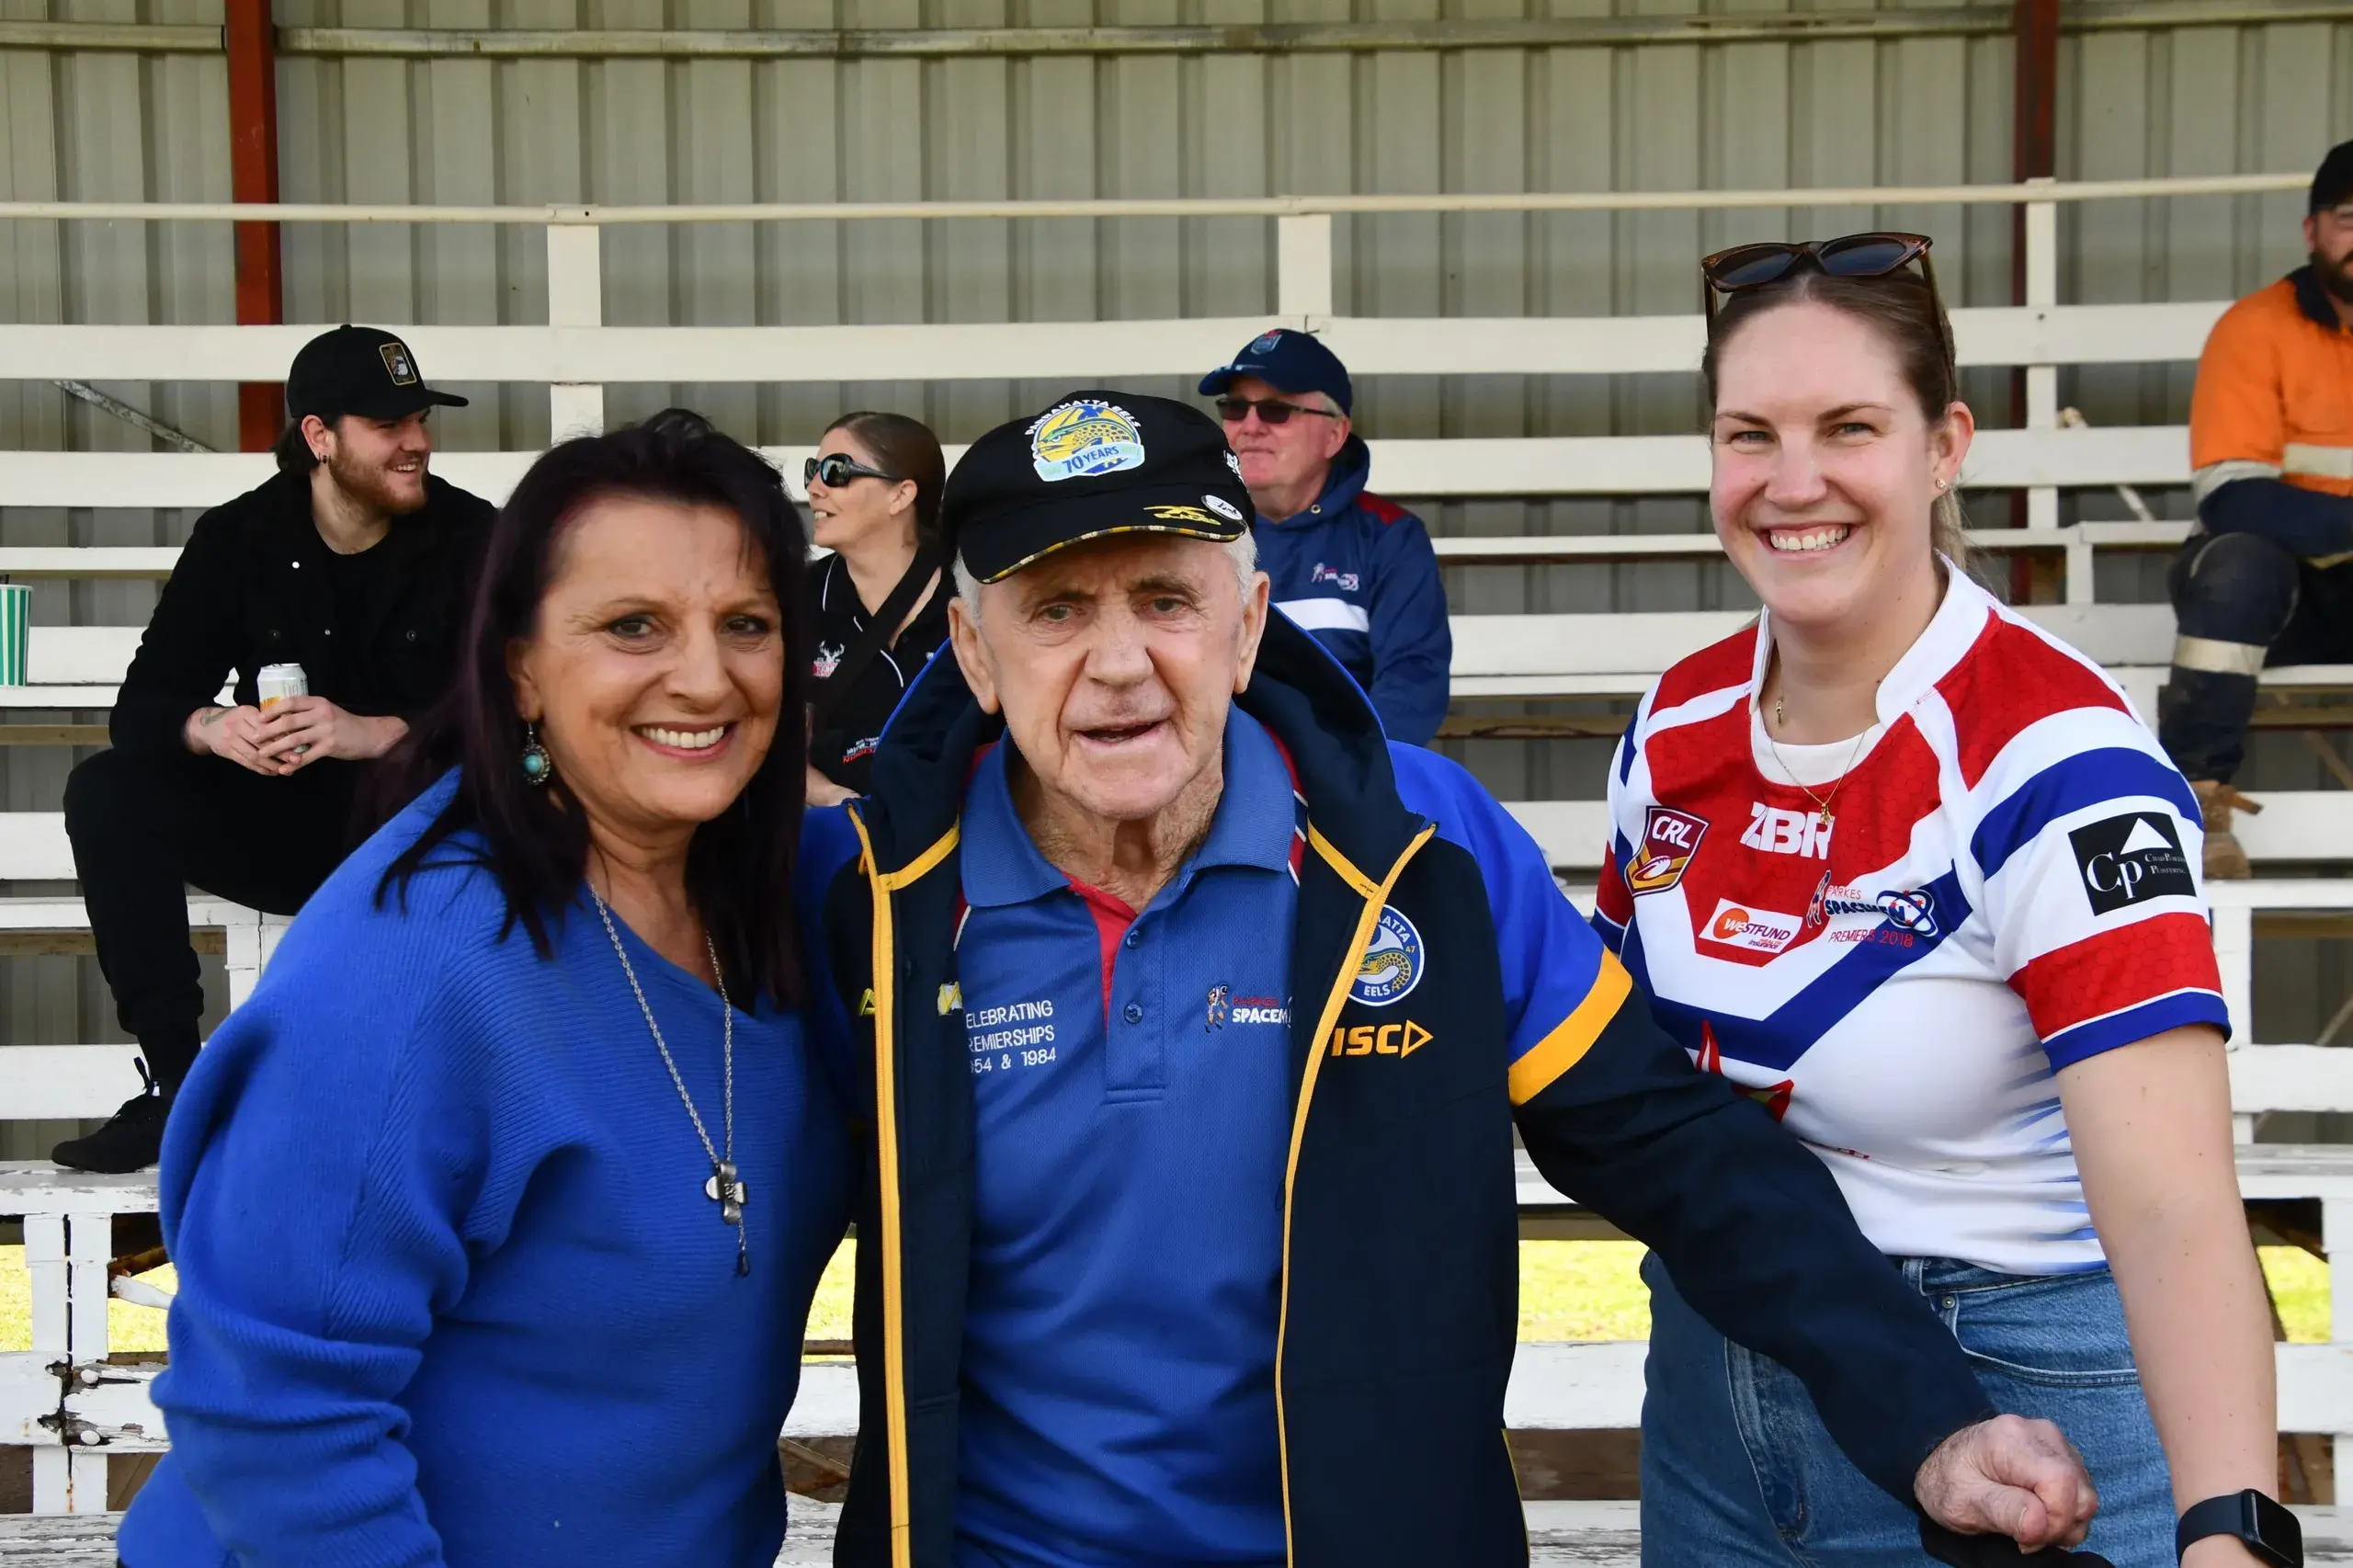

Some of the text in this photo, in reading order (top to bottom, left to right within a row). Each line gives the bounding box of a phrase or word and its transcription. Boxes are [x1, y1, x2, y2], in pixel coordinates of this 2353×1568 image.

[1062, 455, 1085, 473] 70
[1083, 446, 1120, 462] YEARS
[1652, 815, 1692, 849] CRL
[1827, 885, 1862, 900] PARKES
[1378, 915, 1411, 943] ATTA
[1828, 928, 1915, 948] PREMIERS 2018
[1405, 945, 1416, 953] 47
[1363, 983, 1391, 997] EELS
[965, 999, 1054, 1029] ELEBRATING
[1233, 1007, 1291, 1024] SPACEM
[968, 1025, 1055, 1052] REMIERSHIPS
[1331, 1024, 1403, 1057] ISC
[970, 1046, 1056, 1074] 54 & 1984
